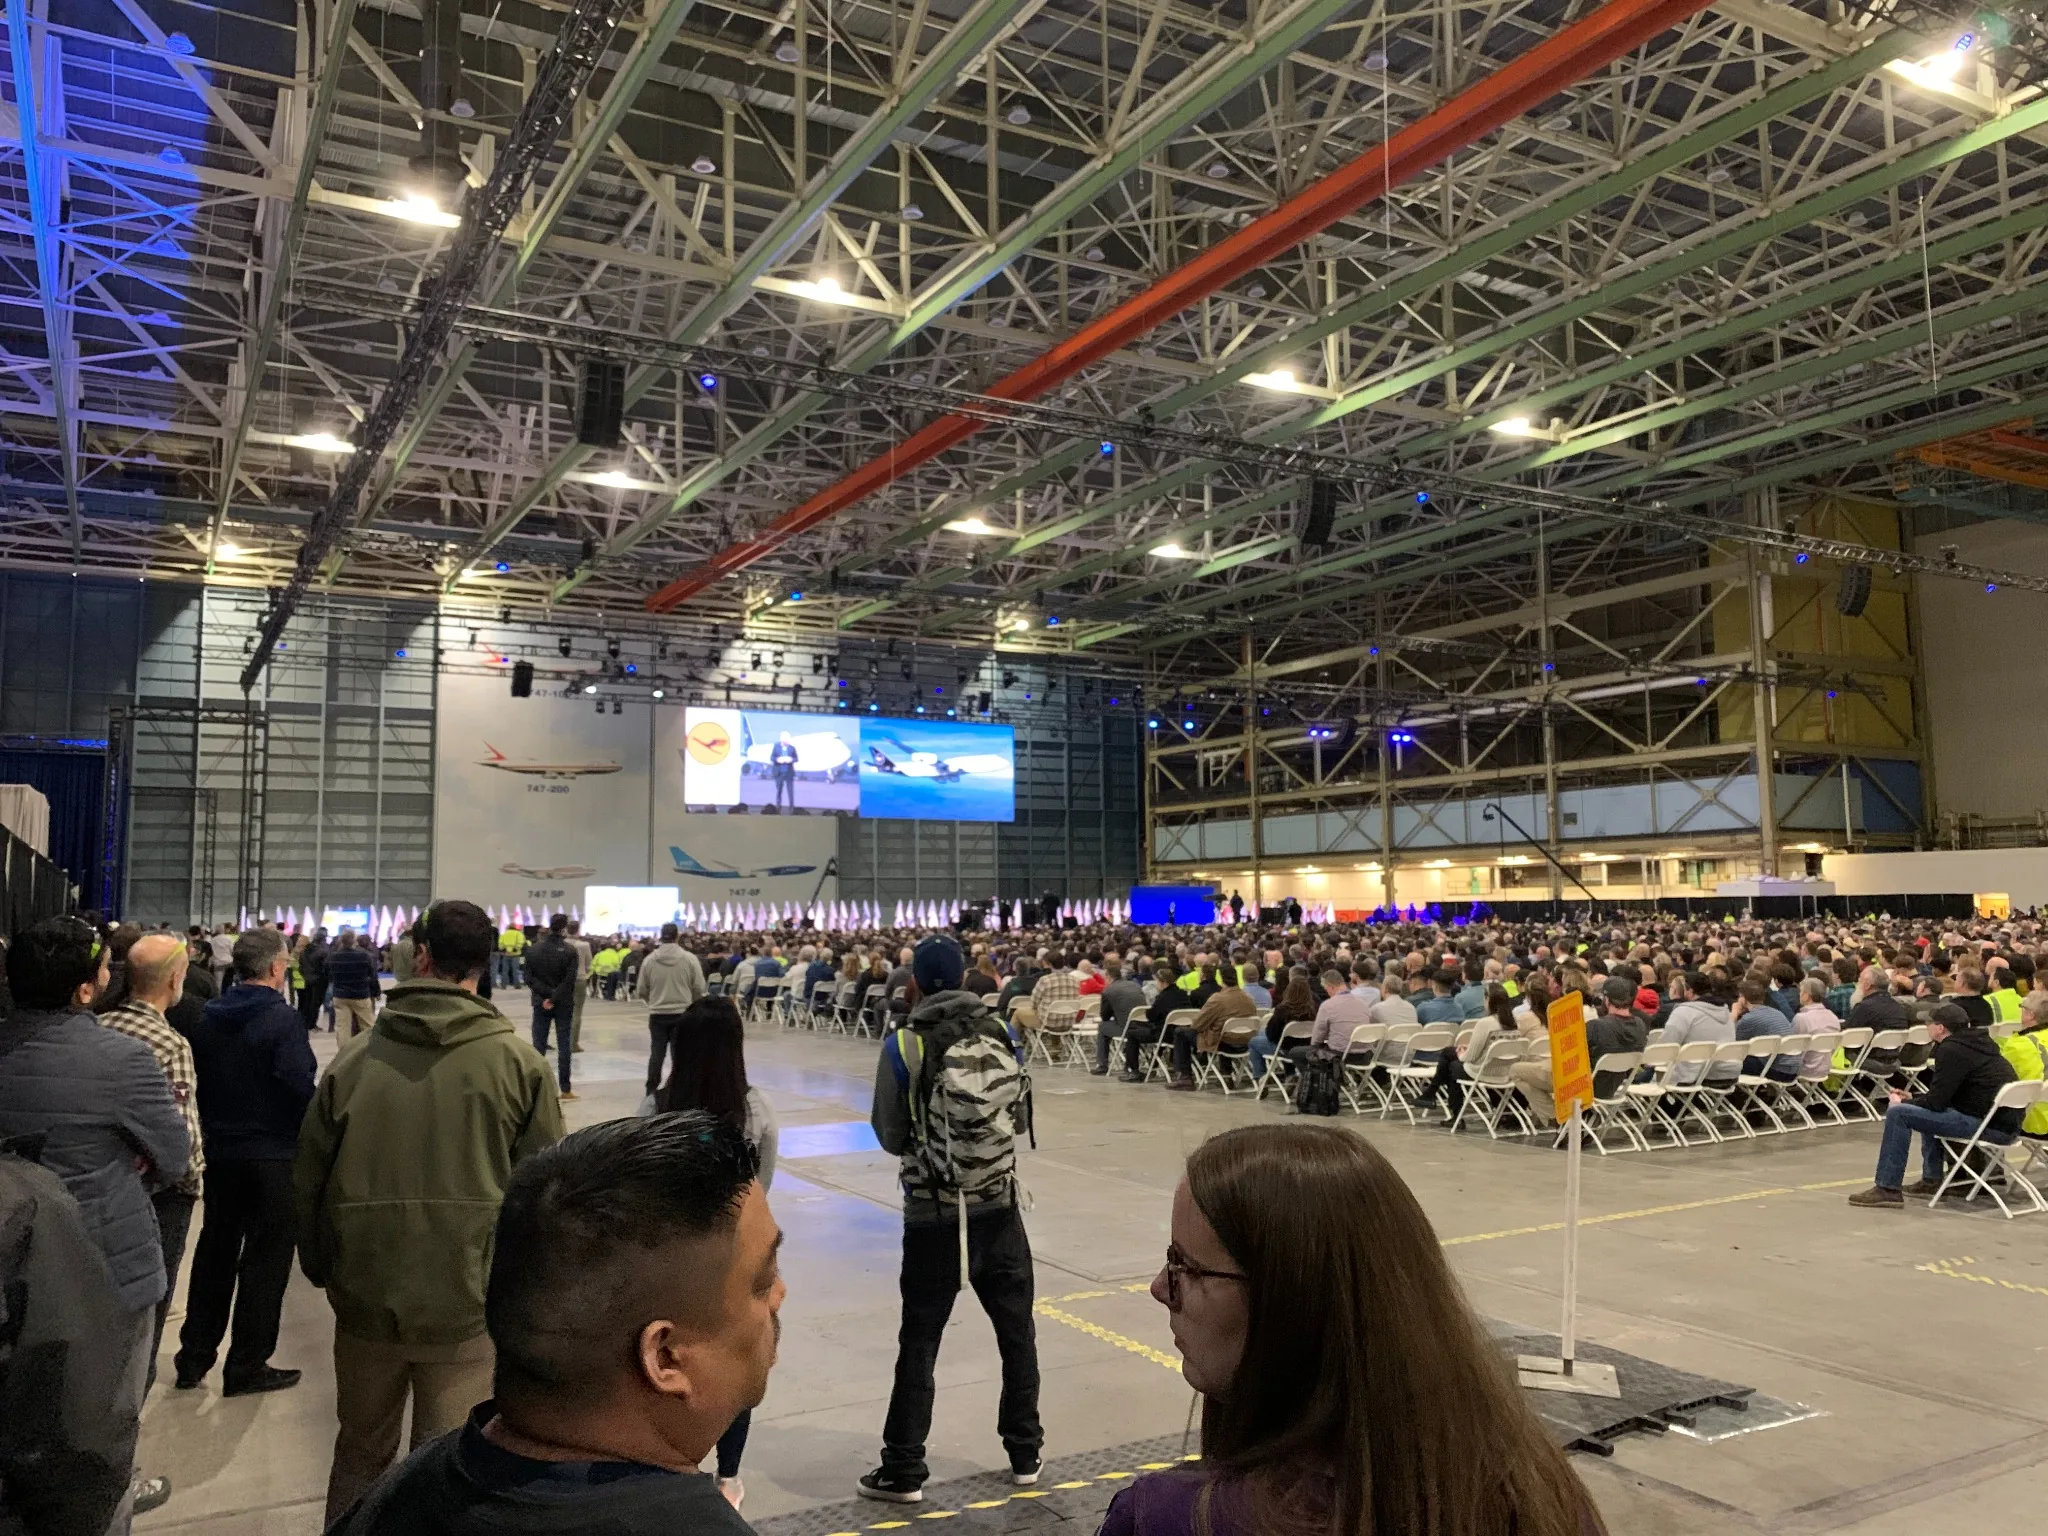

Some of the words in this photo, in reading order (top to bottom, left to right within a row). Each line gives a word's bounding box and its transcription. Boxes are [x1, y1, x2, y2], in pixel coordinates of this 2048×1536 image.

[527, 784, 570, 794] 747-200
[528, 890, 547, 899] 747
[1552, 1005, 1580, 1034] CAUTION
[1558, 1074, 1589, 1103] CROSSING
